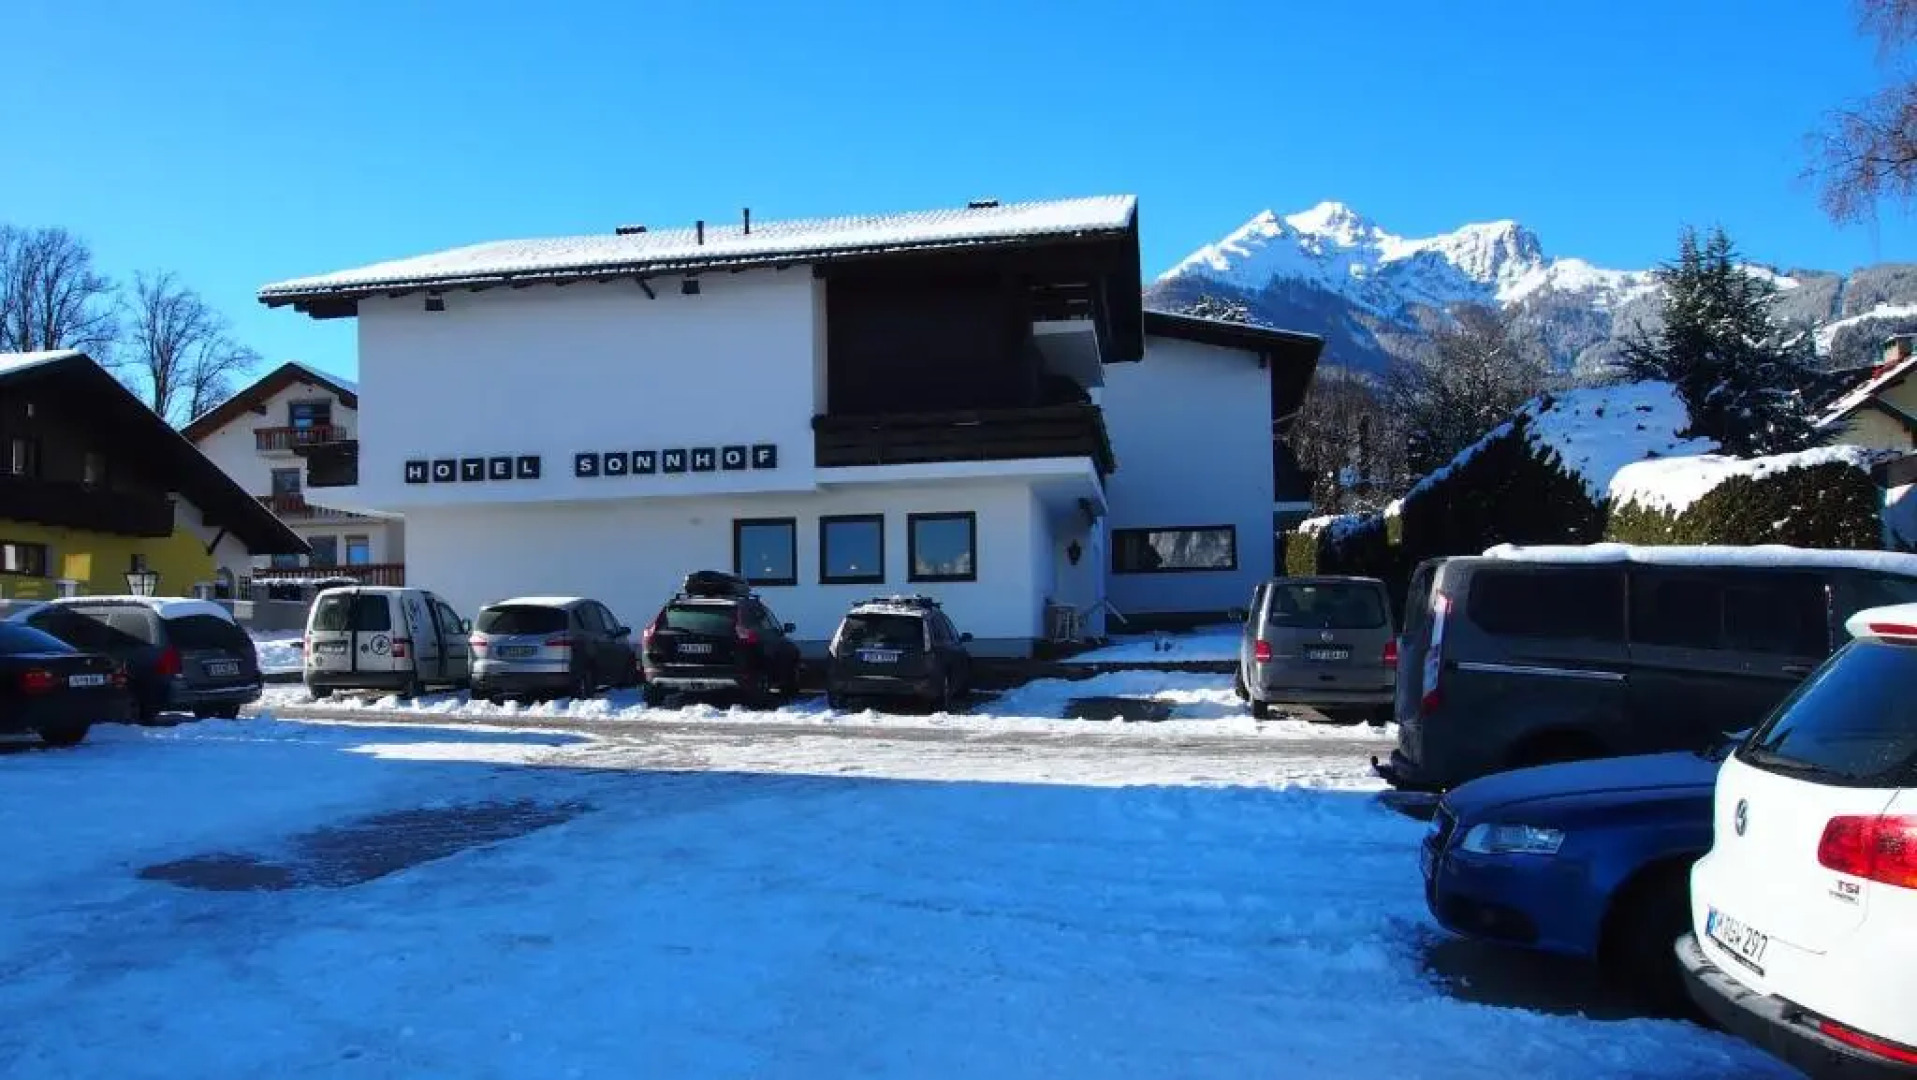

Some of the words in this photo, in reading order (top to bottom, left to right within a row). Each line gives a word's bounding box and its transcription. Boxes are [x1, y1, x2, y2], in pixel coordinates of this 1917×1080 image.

[408, 460, 534, 480] HOTEL
[578, 448, 772, 472] SONNHOF
[1837, 880, 1860, 894] TSI
[1742, 926, 1768, 961] 297
